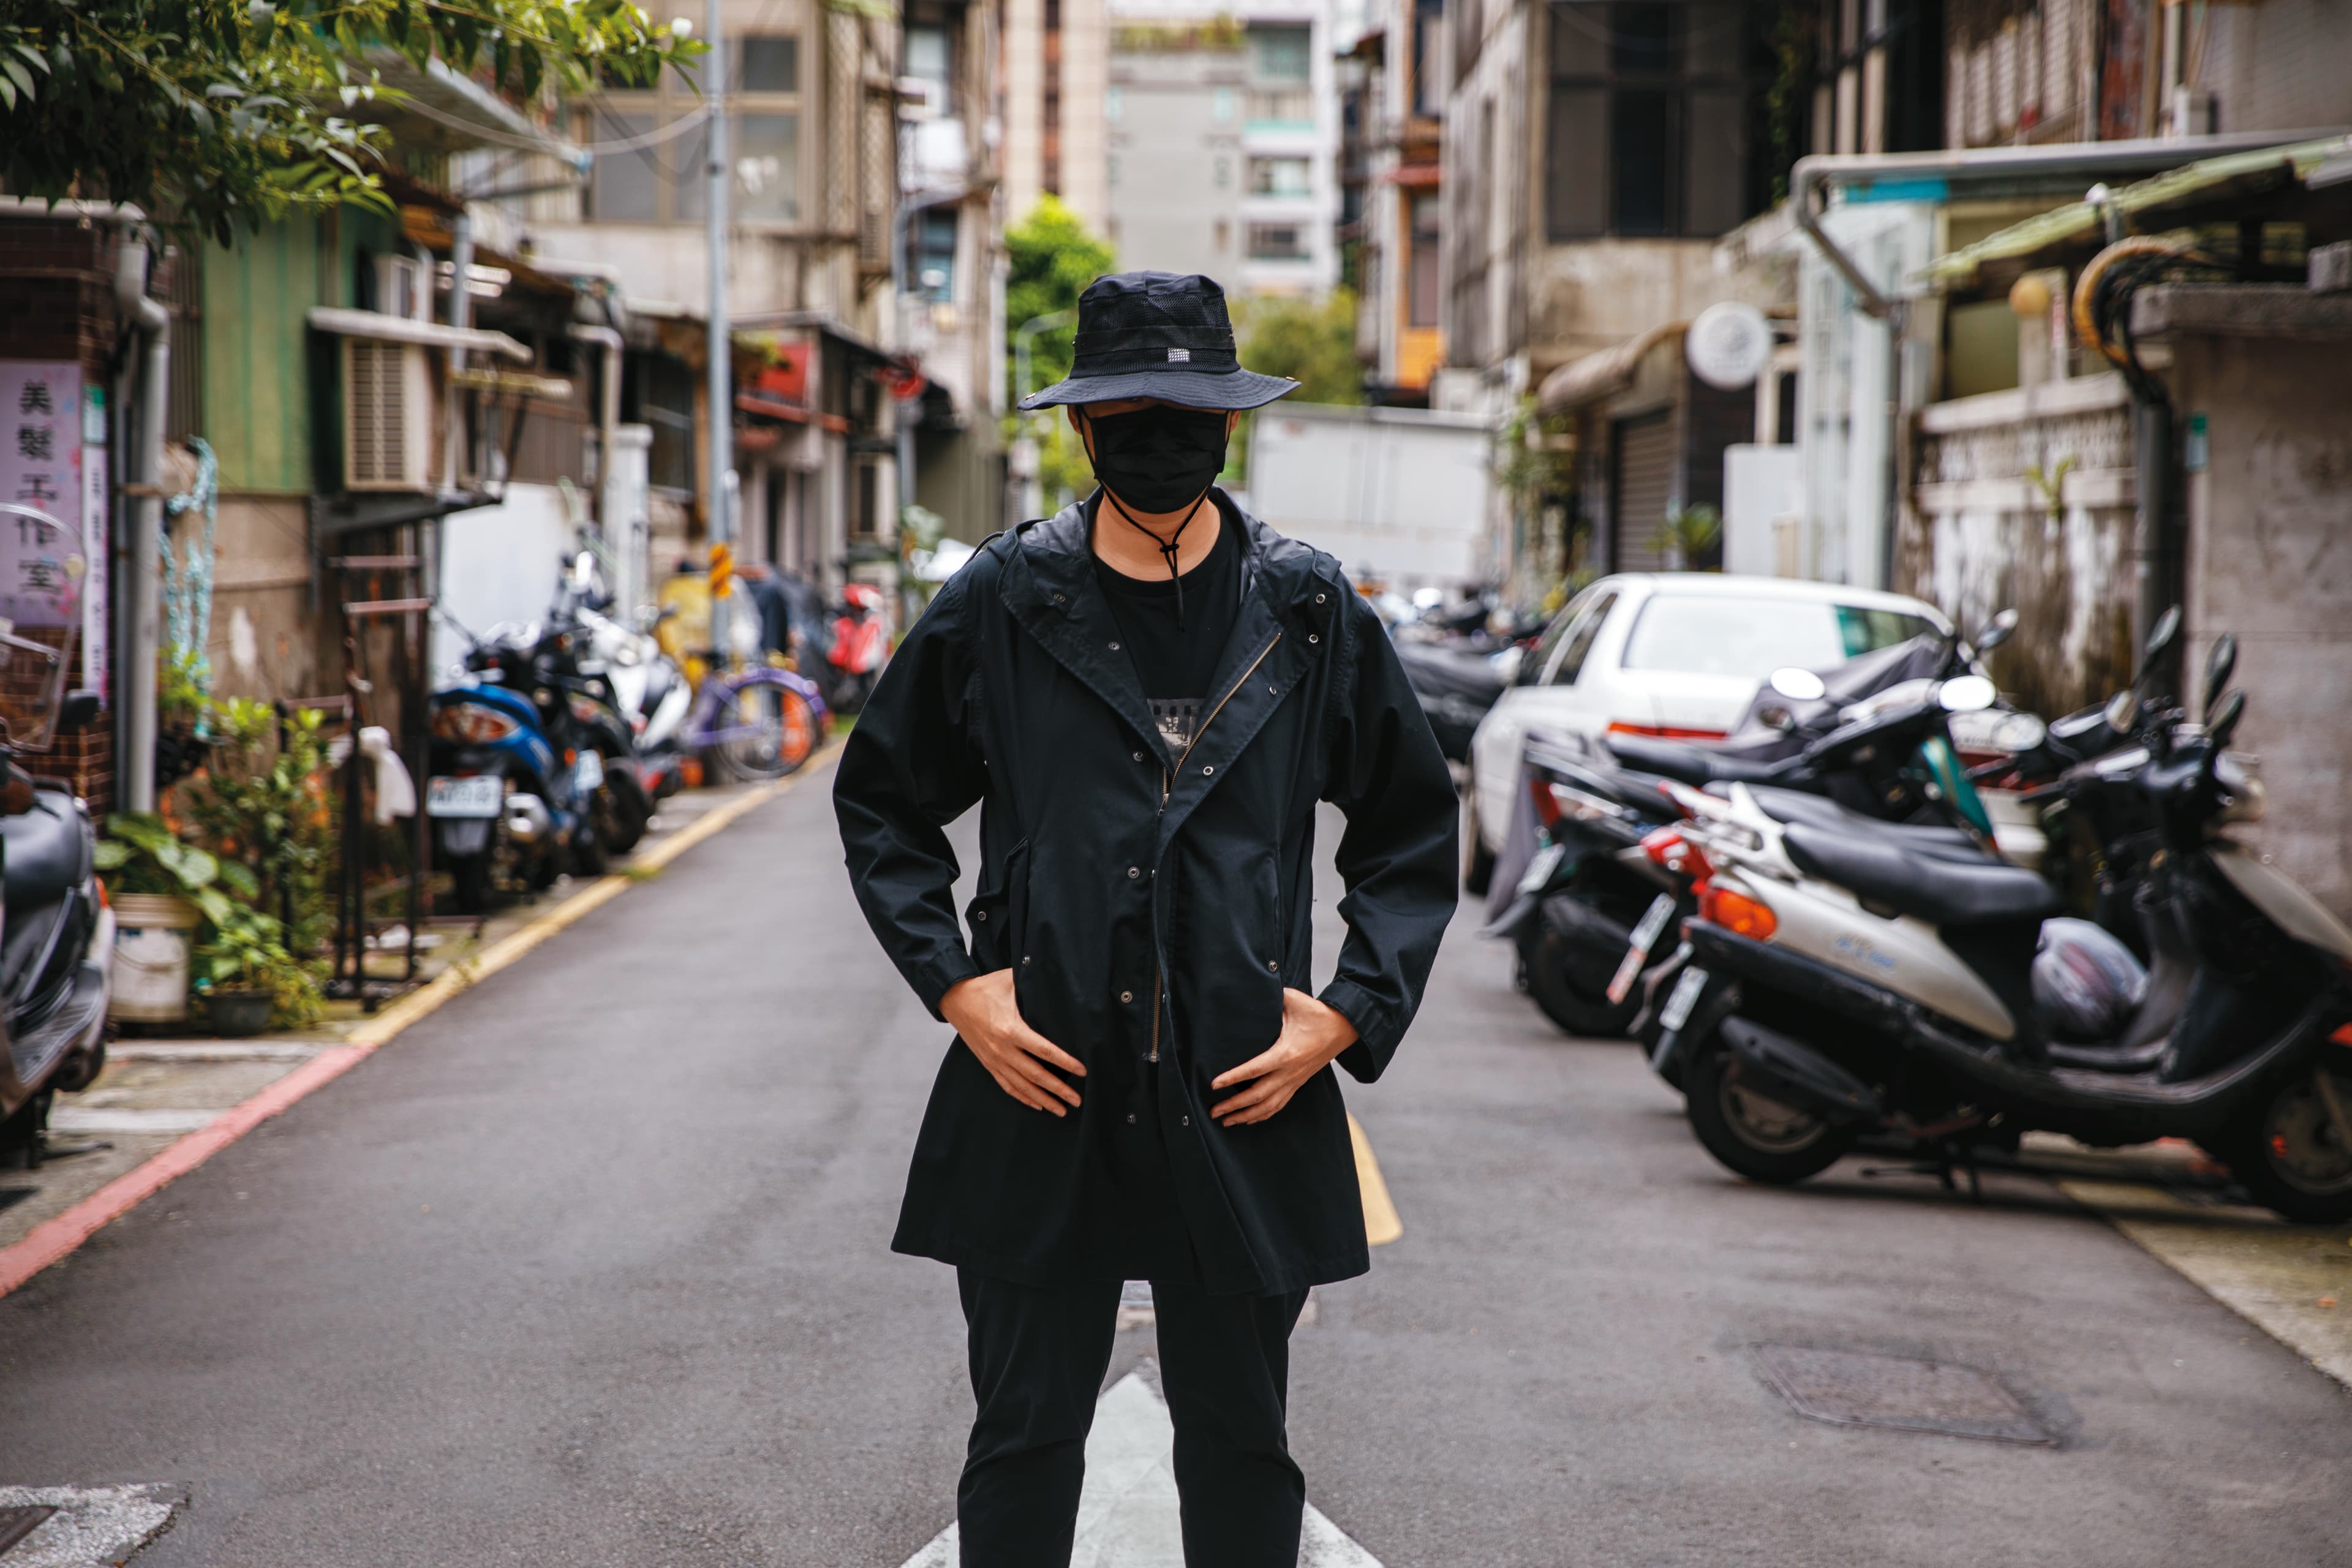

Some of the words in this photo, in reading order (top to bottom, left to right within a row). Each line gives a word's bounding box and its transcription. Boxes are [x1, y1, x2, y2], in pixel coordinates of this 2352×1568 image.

[17, 379, 60, 593] 美髮工作室
